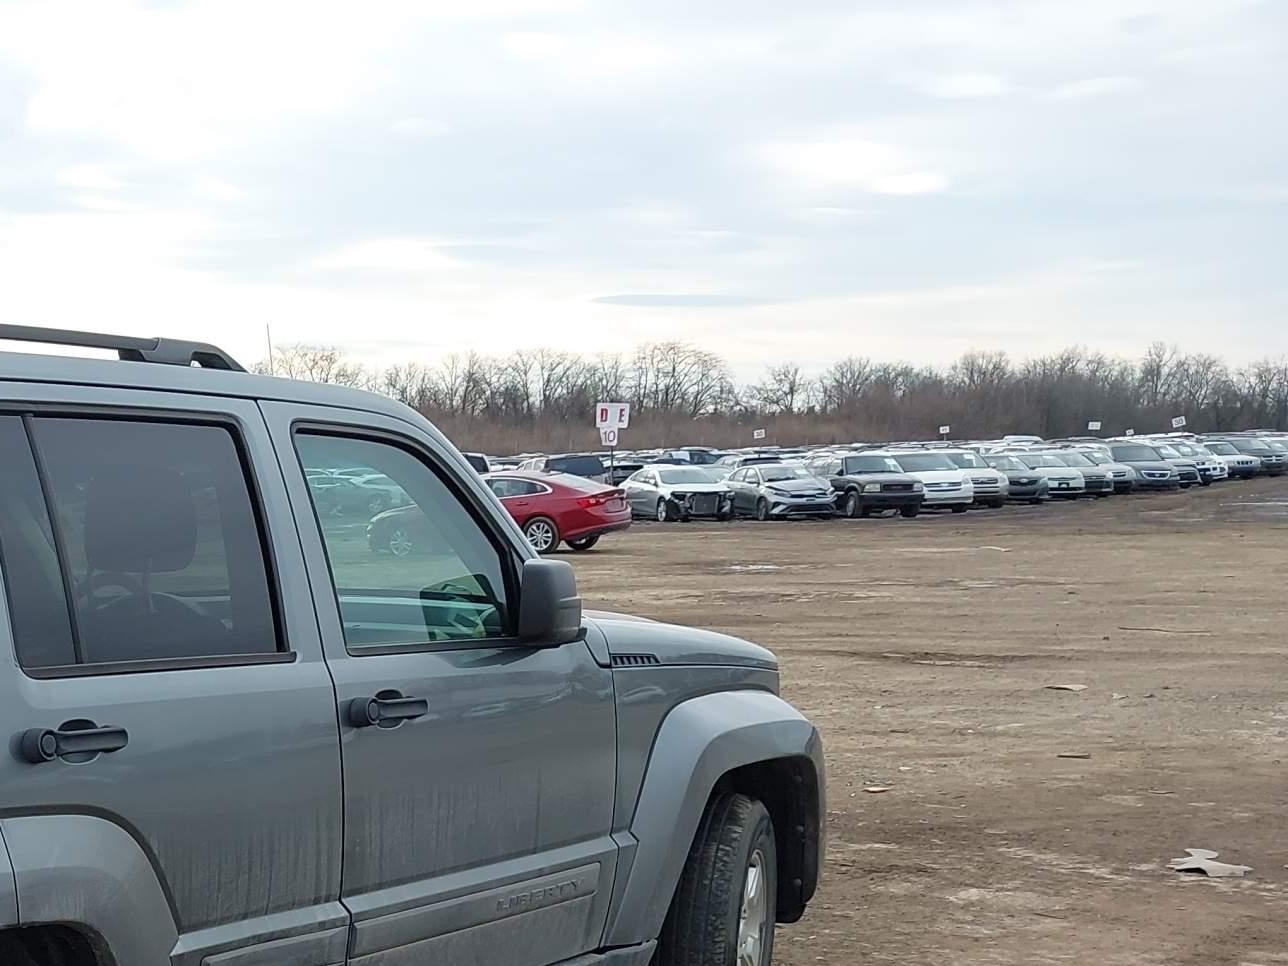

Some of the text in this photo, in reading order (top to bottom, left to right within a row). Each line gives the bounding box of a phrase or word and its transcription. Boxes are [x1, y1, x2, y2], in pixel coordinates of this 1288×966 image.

[600, 408, 625, 422] D E
[603, 430, 616, 442] 10
